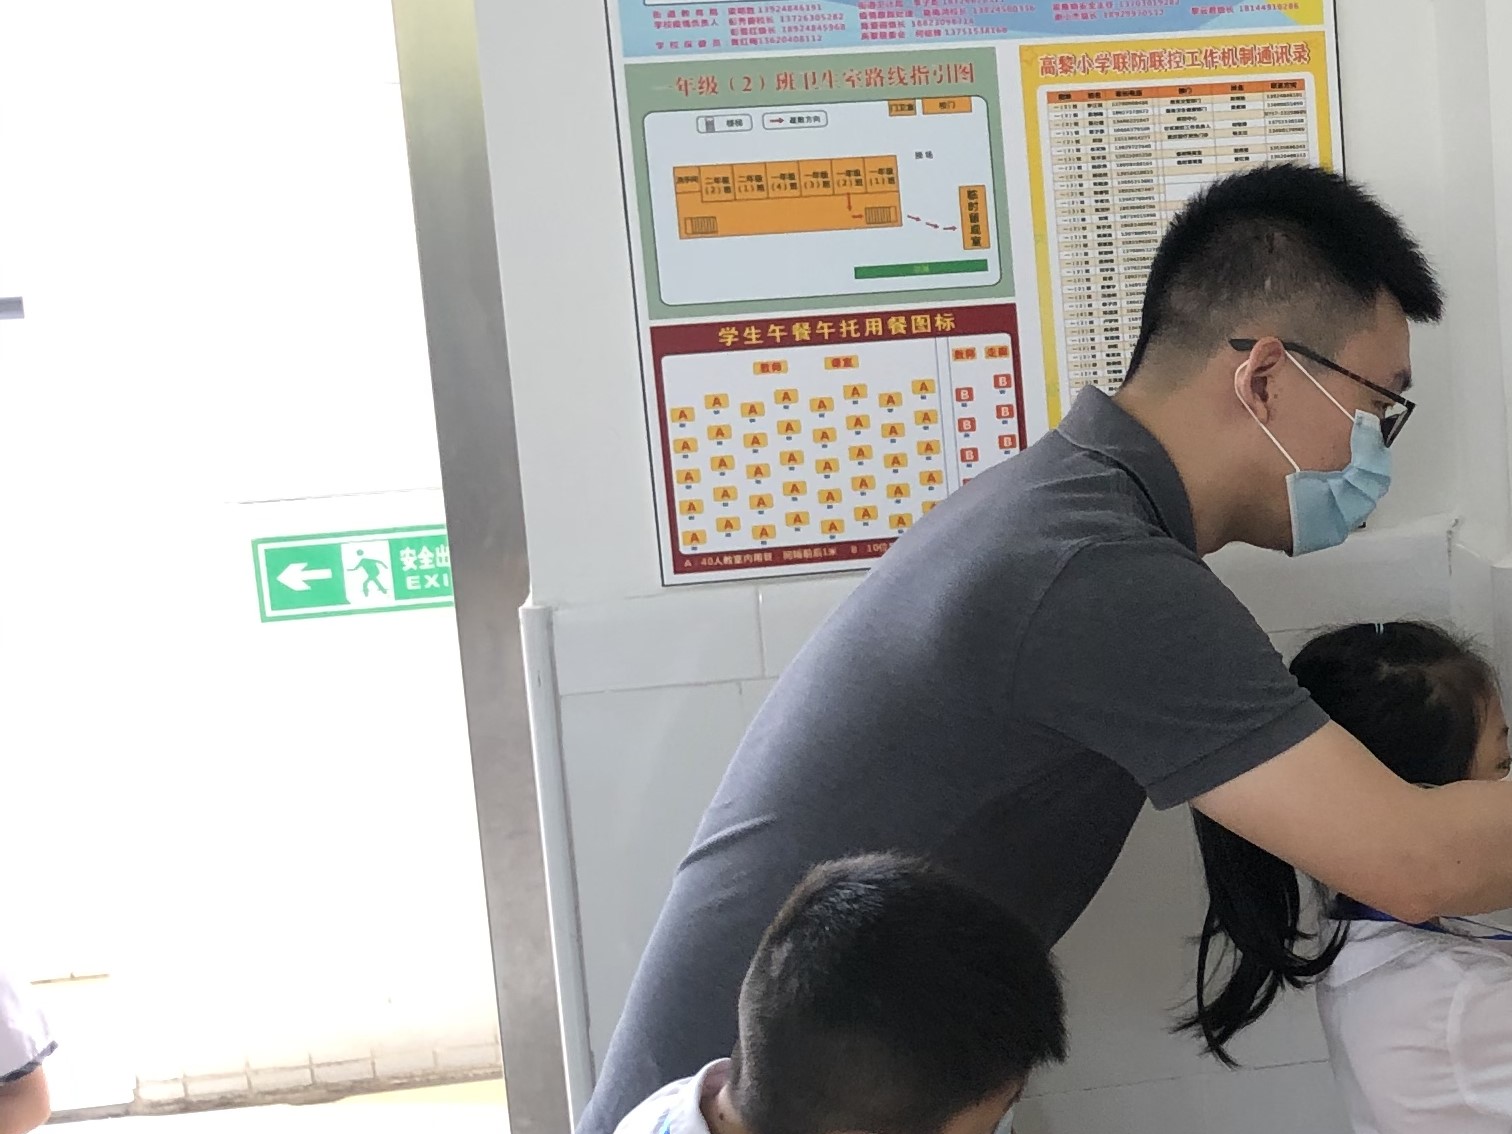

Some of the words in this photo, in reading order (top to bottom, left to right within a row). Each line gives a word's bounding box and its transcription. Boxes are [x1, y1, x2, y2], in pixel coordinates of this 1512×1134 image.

[1038, 42, 1312, 77] 高黎小学联防联控工作机制通讯录
[717, 312, 957, 347] 学生午餐午托用餐图标
[998, 376, 1007, 387] B
[960, 388, 969, 400] B
[1001, 406, 1009, 416] B
[963, 419, 971, 430] B
[1004, 436, 1012, 447] B
[966, 450, 974, 460] B
[399, 543, 451, 572] 安全出
[406, 574, 450, 590] EXI
